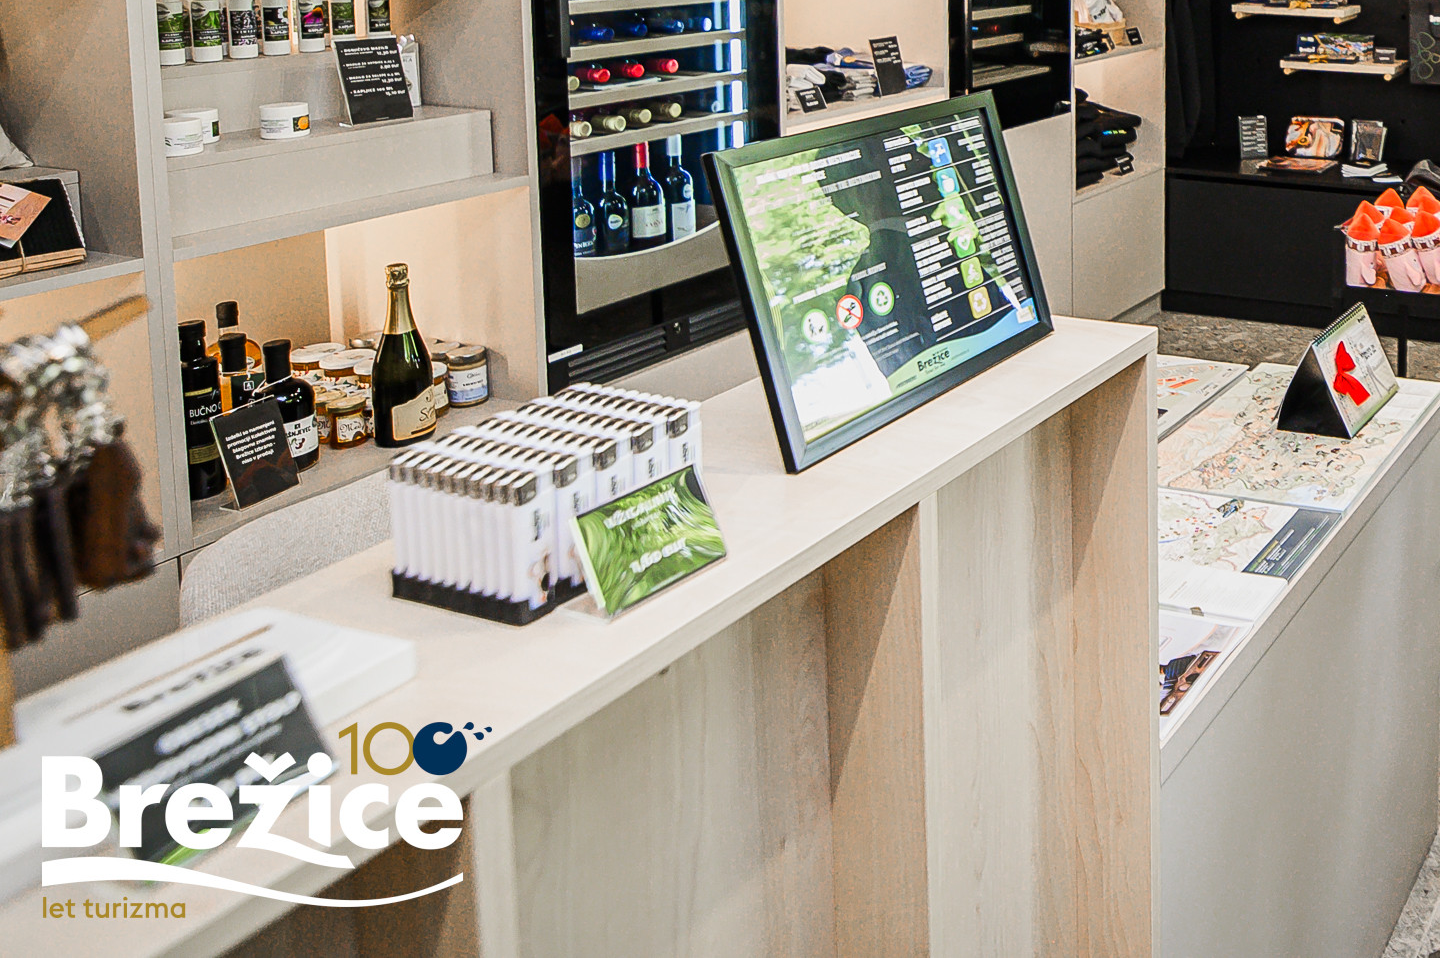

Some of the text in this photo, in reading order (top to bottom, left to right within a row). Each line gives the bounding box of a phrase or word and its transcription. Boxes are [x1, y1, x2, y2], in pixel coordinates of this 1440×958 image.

[917, 349, 951, 372] Brežice
[189, 404, 218, 418] BUČNO
[235, 449, 254, 460] Brežice
